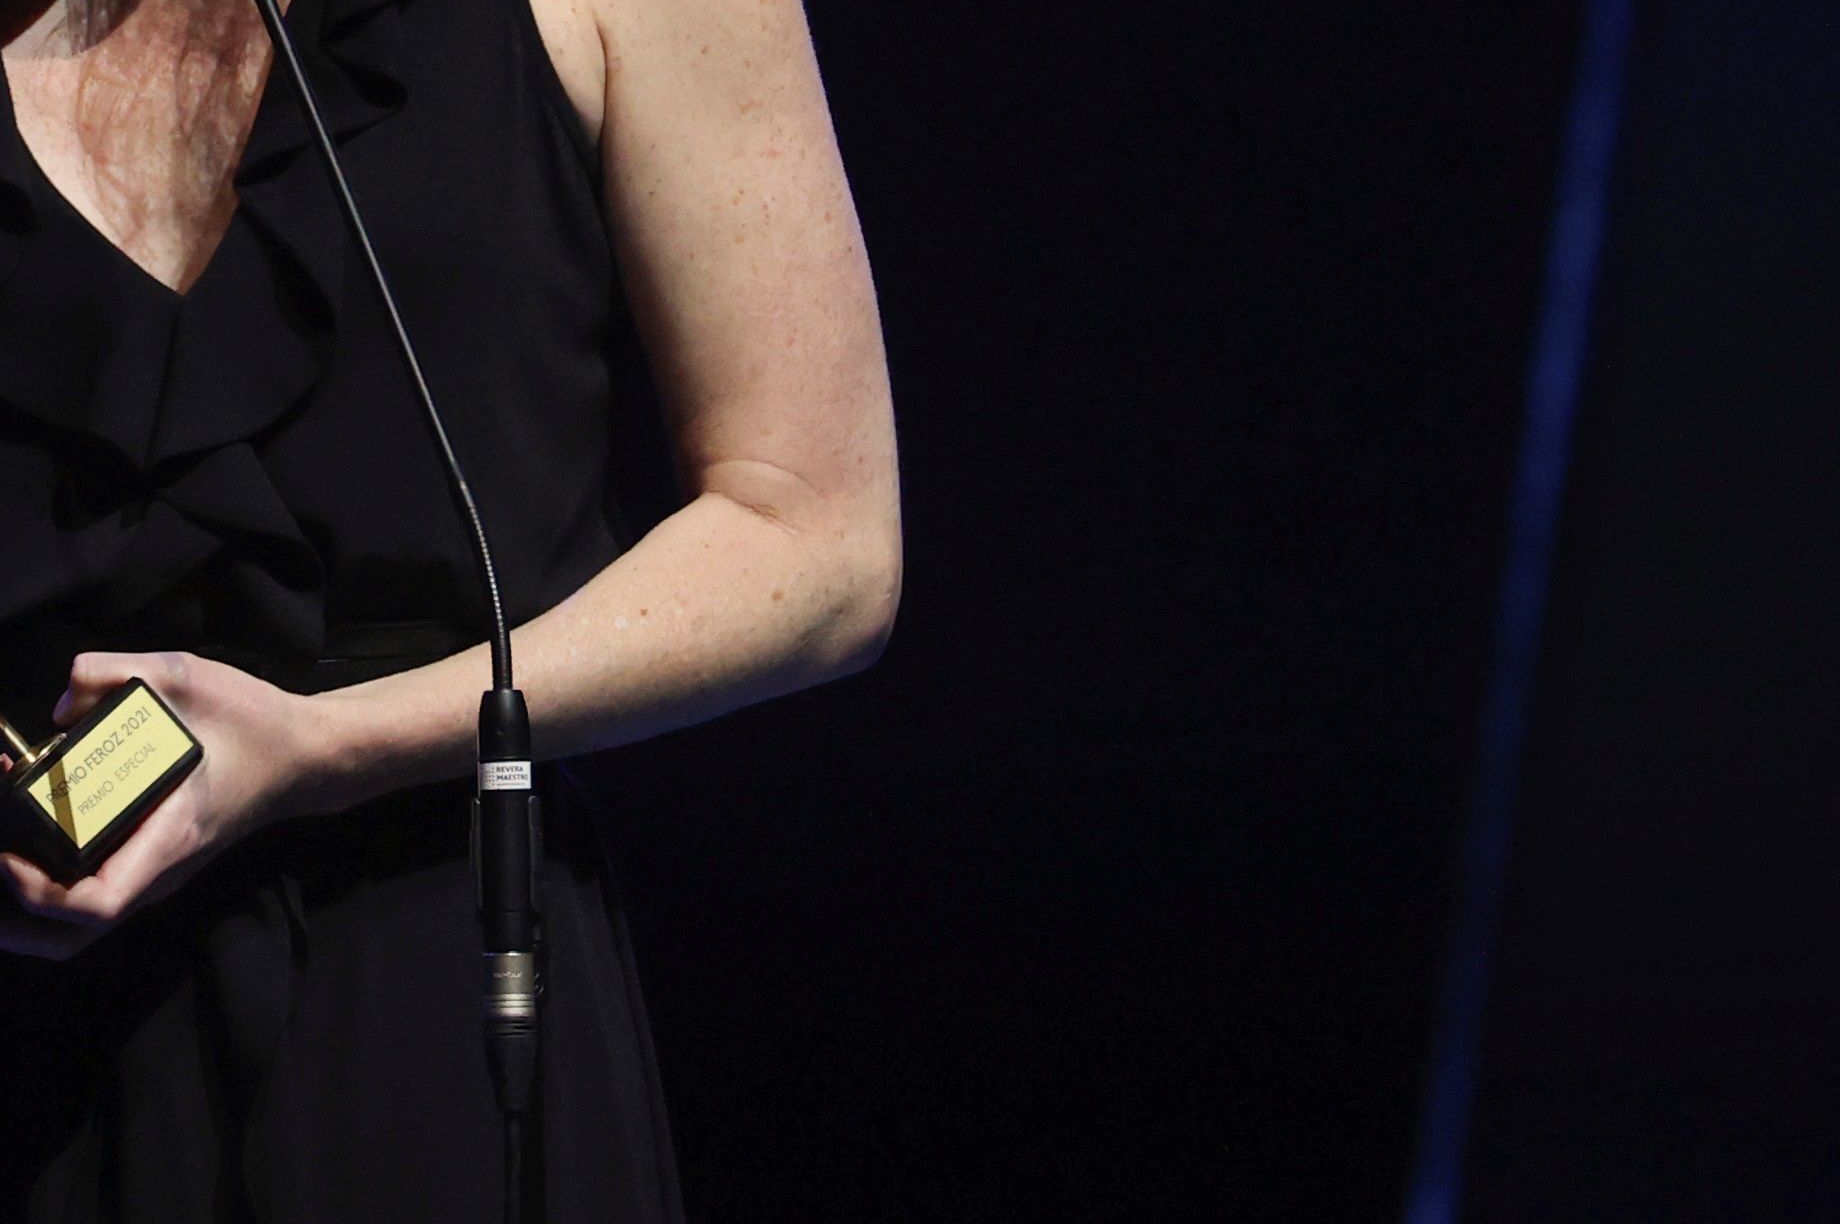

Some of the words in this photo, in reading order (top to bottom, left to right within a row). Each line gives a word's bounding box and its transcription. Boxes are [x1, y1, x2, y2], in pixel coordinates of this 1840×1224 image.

[46, 765, 88, 804] PREMIO
[84, 731, 124, 771] FEROZ
[121, 706, 151, 737] 2021
[78, 780, 115, 816] PREMIO
[114, 742, 158, 782] ESPECIAL
